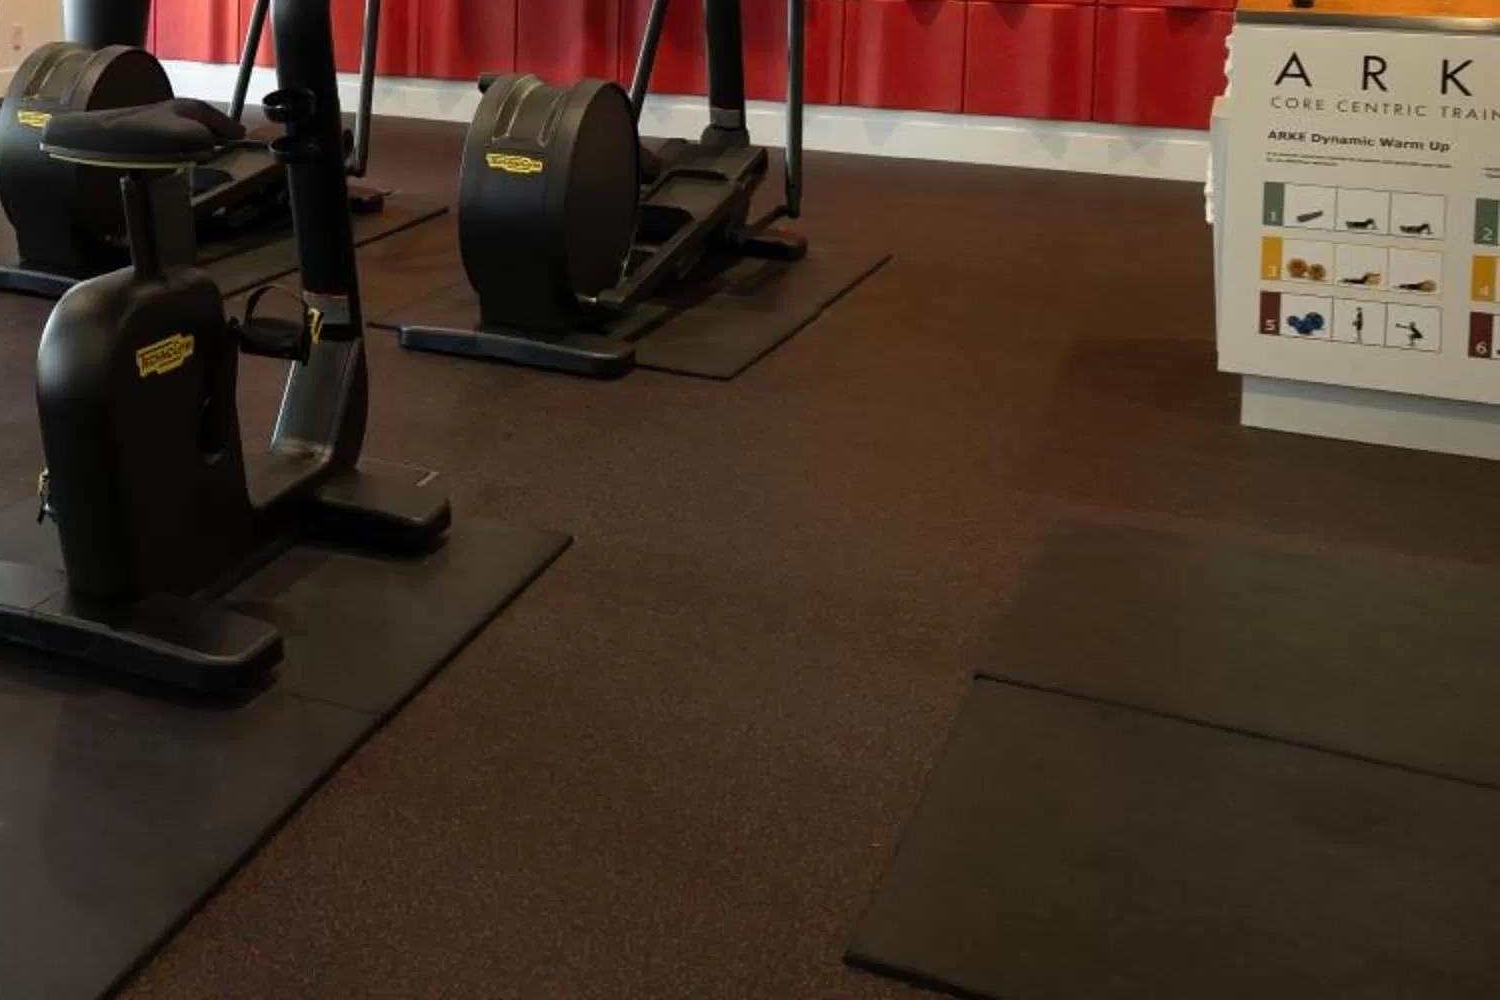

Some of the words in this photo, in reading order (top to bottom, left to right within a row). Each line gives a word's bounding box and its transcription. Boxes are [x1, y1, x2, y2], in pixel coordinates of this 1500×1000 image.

[1271, 97, 1325, 111] CORE
[1336, 100, 1428, 117] CENTRIC
[1311, 133, 1375, 147] Dynamic
[1380, 137, 1424, 151] Warm
[1429, 141, 1451, 153] Up
[1475, 341, 1487, 354] 6
